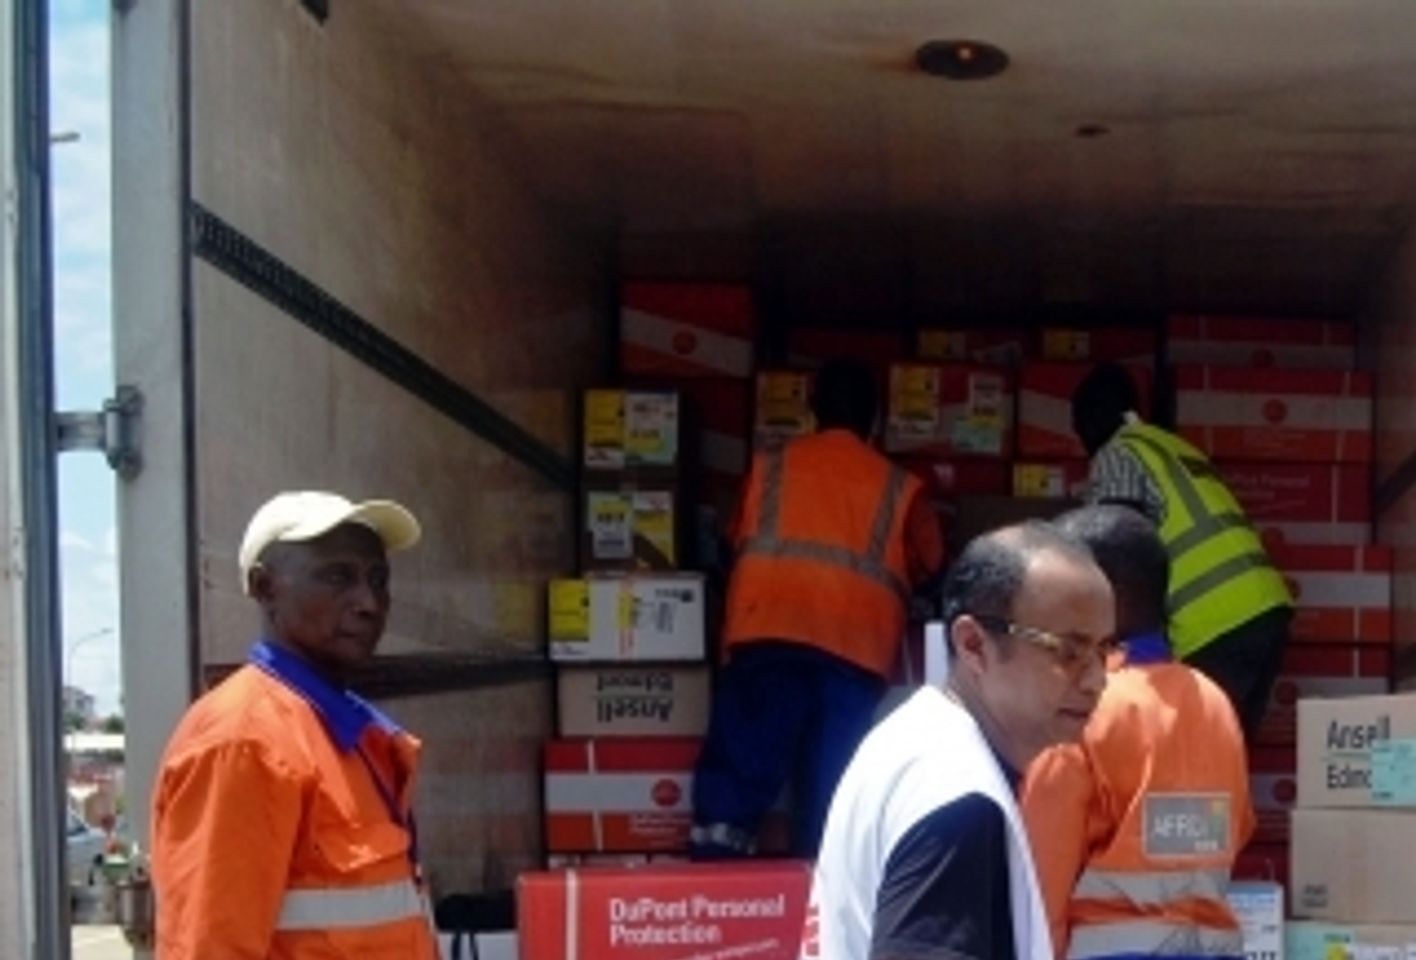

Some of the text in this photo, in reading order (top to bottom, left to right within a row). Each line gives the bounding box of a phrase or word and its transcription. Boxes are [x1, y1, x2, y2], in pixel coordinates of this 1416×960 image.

[609, 892, 786, 922] DuPont Personal
[609, 921, 723, 947] Protection
